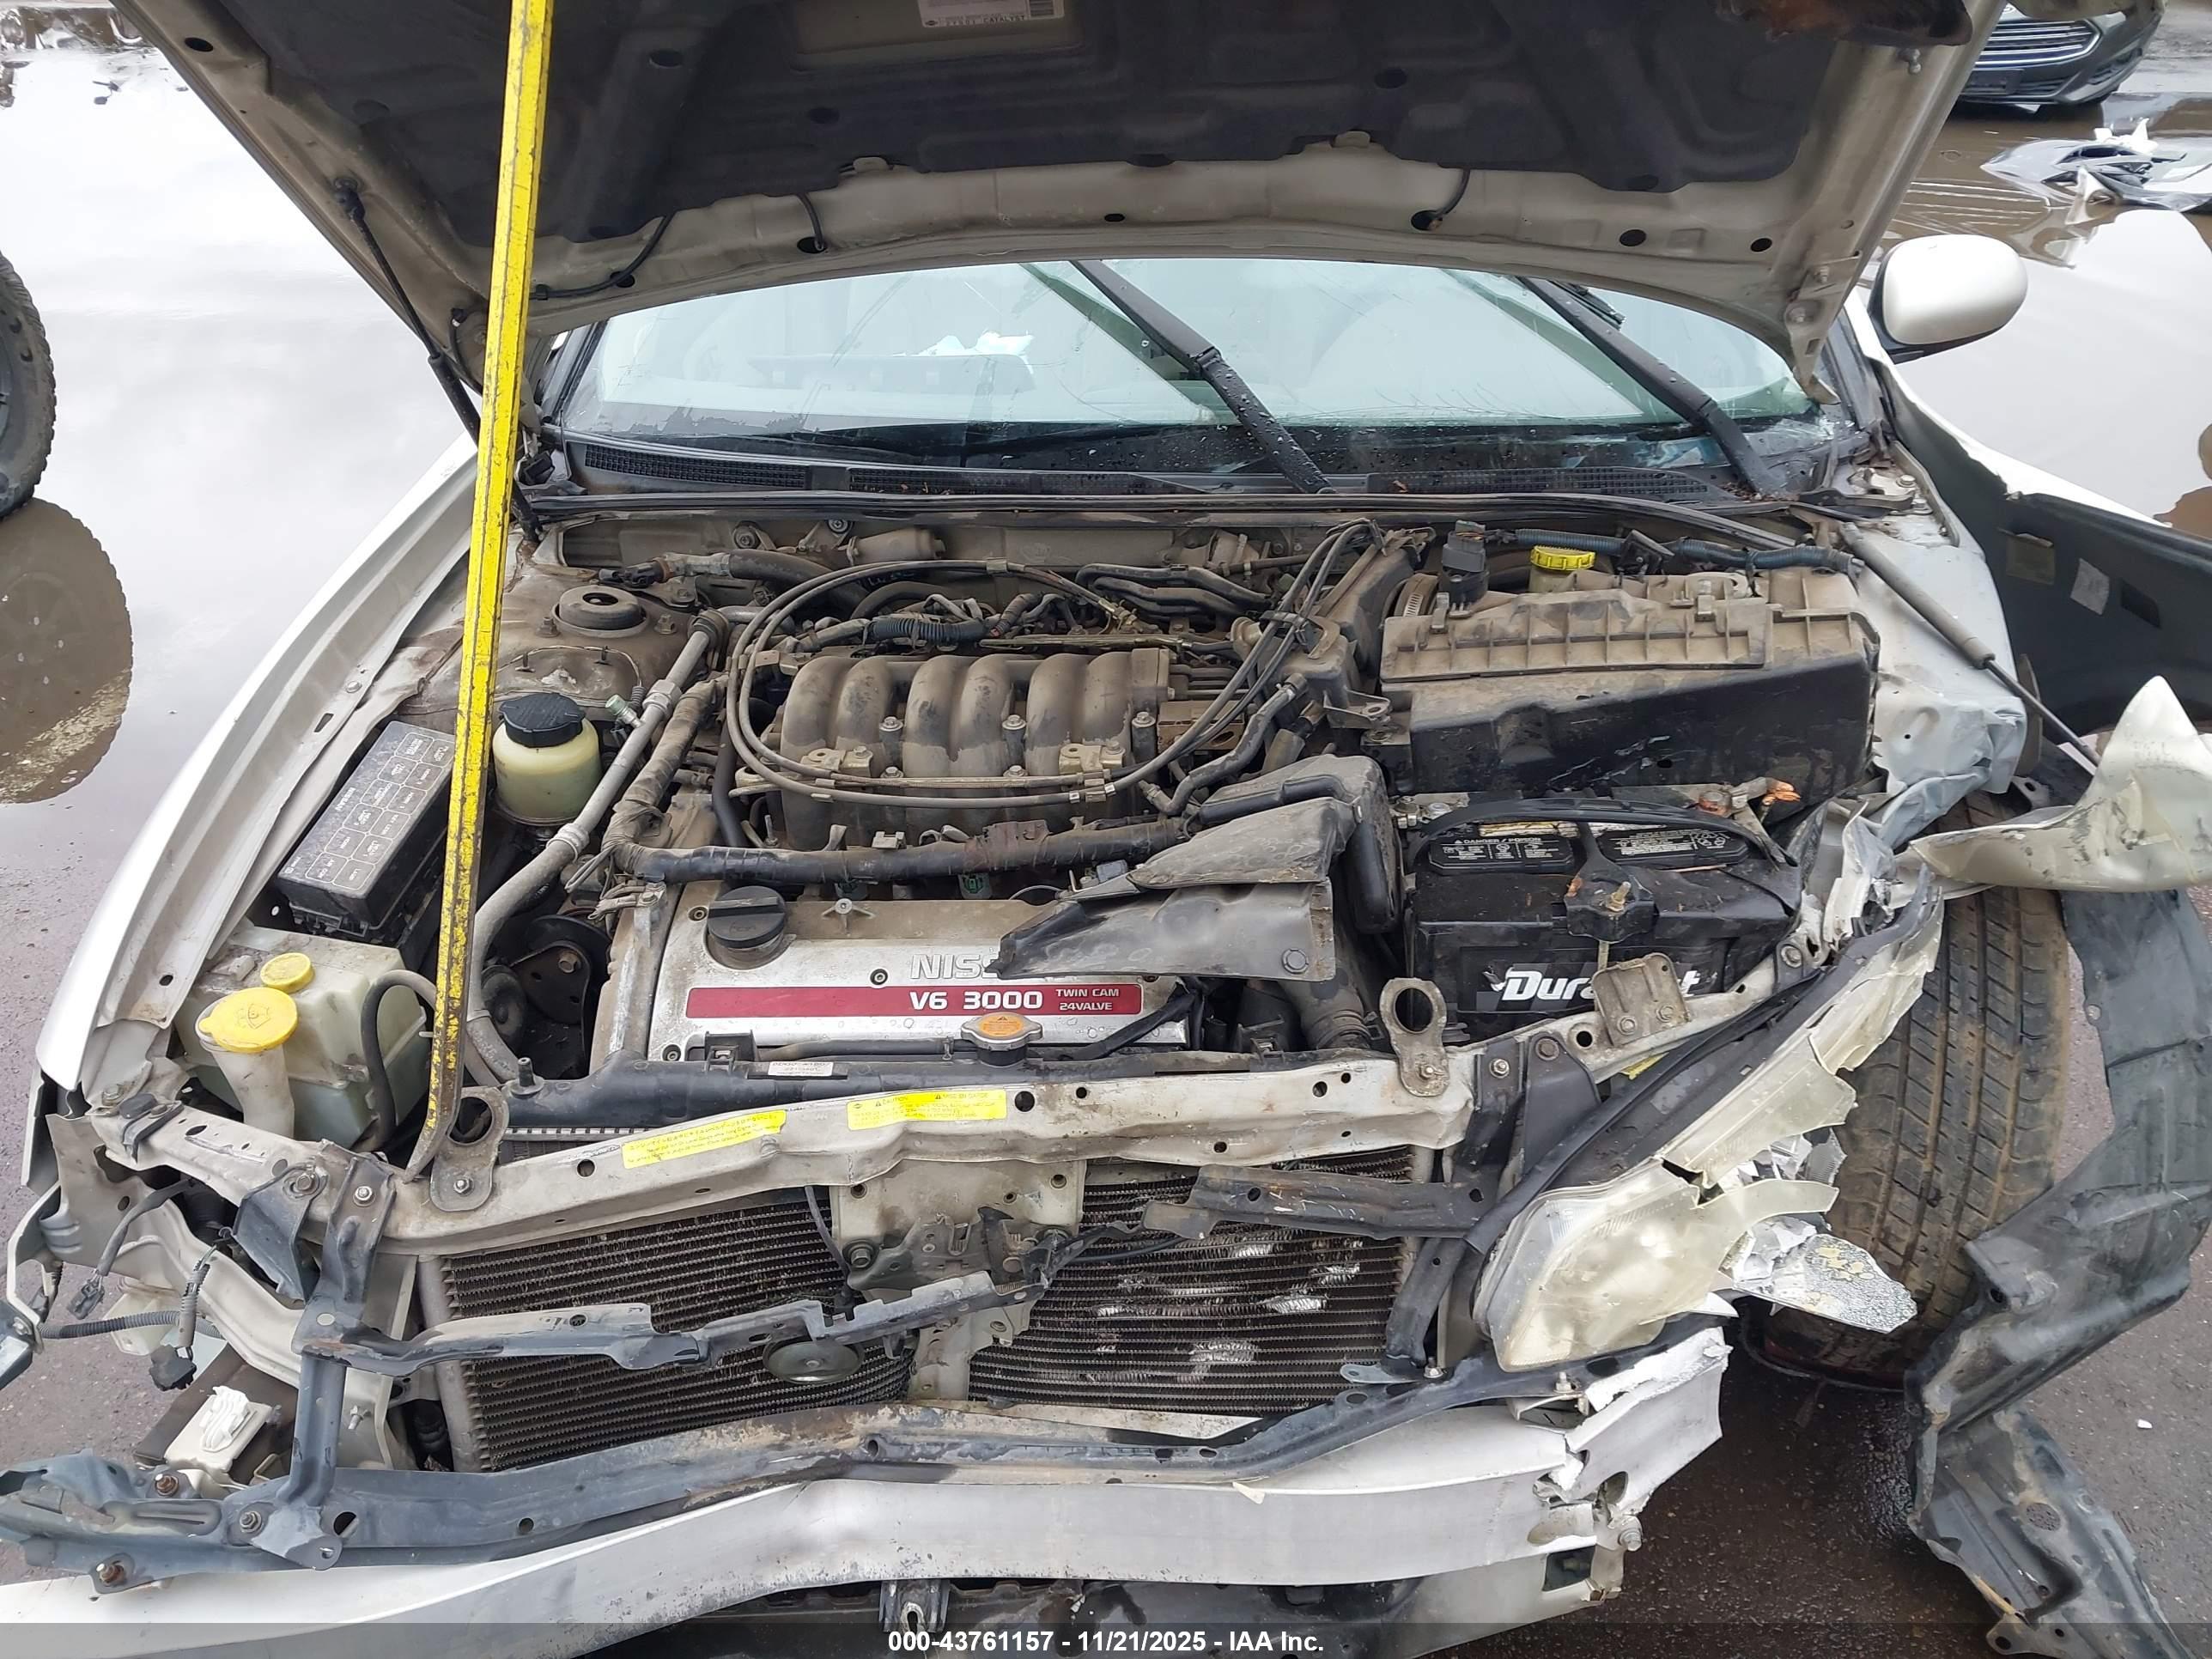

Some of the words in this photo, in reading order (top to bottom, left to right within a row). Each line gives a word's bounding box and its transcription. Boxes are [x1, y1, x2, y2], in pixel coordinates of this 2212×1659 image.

[334, 787, 356, 811] NISSAN
[909, 992, 948, 1010] V6
[963, 991, 1043, 1010] 3000
[1060, 1002, 1113, 1011] 24VALVE
